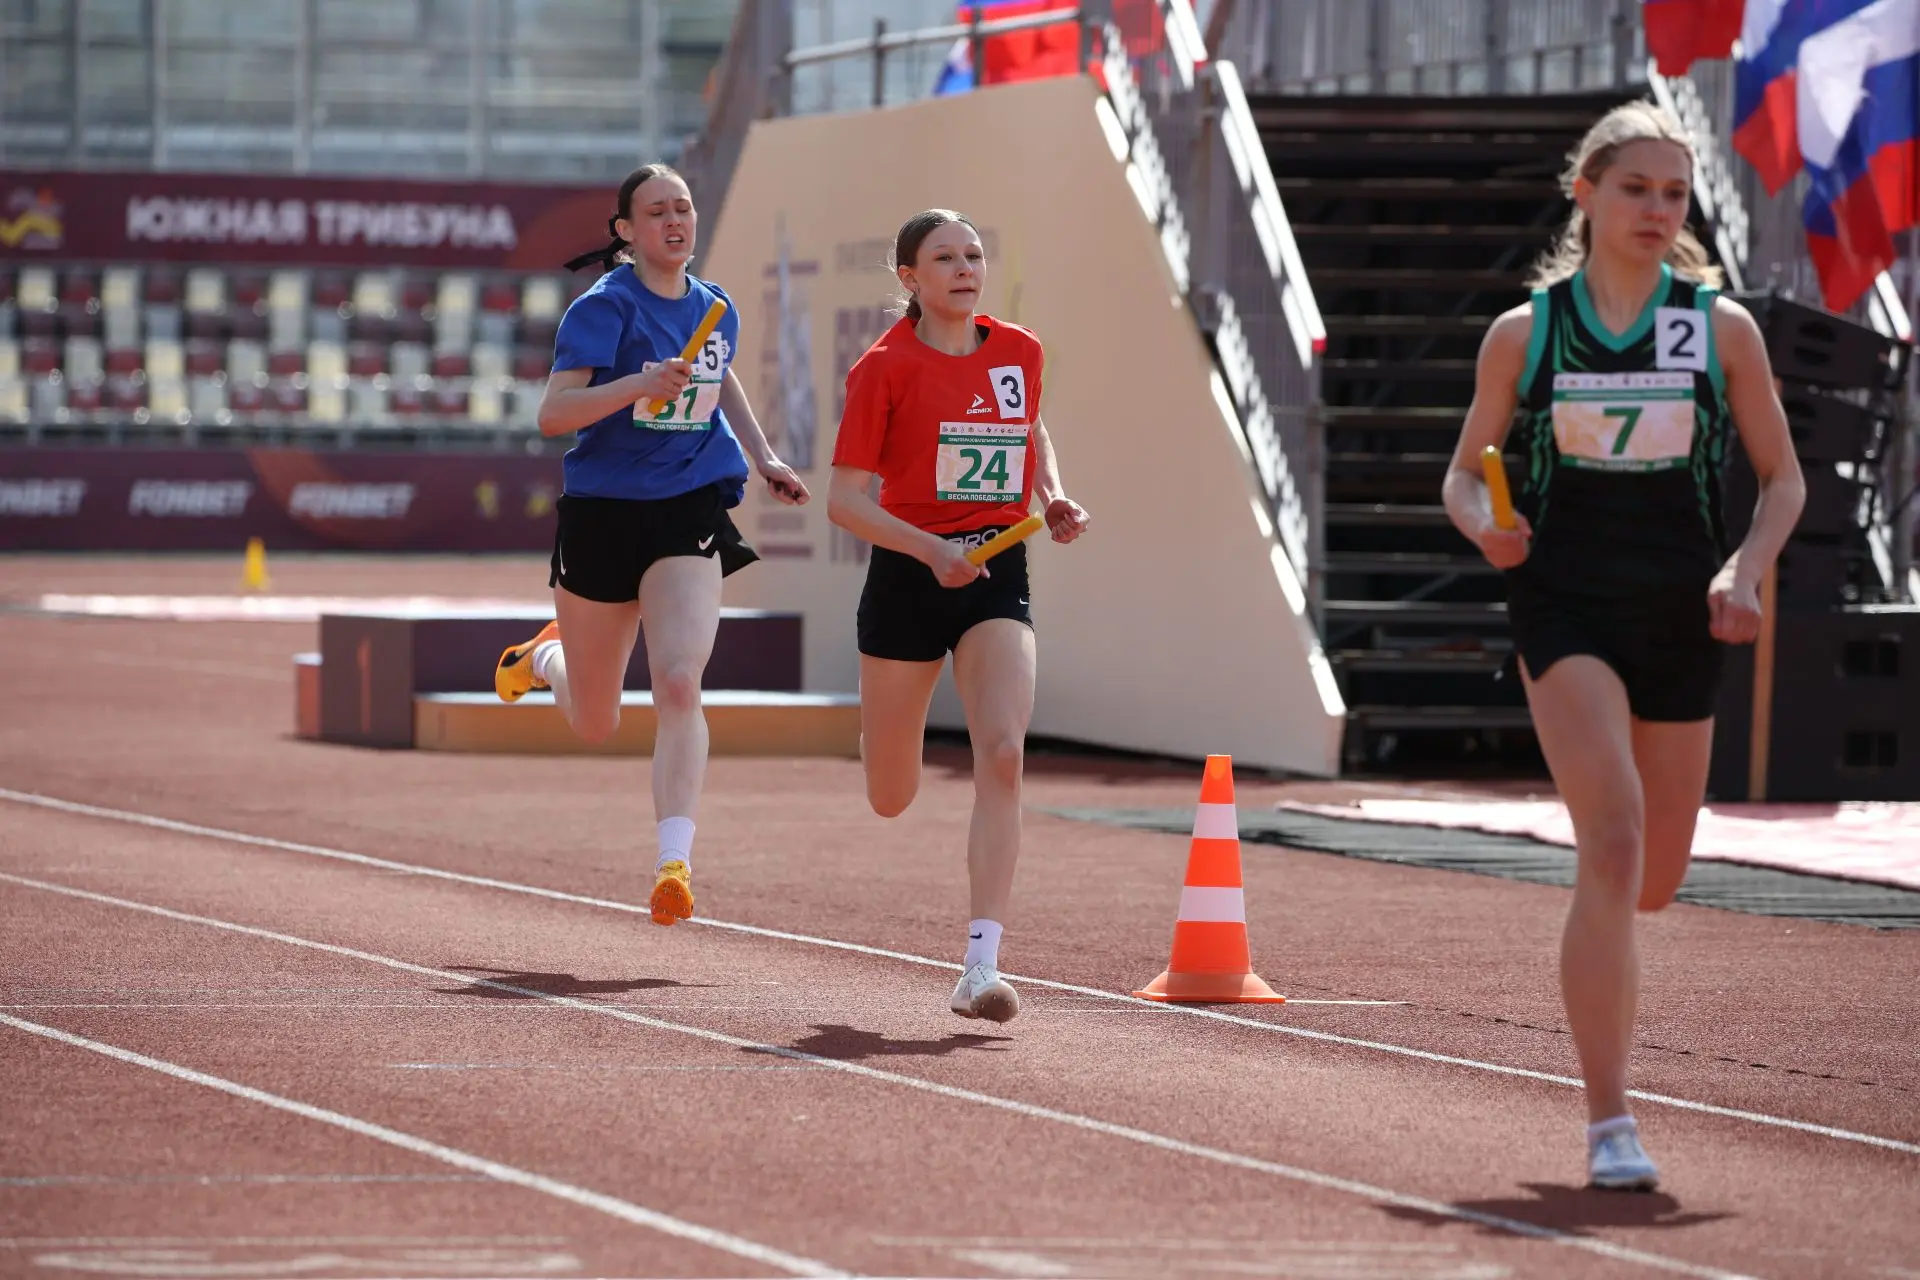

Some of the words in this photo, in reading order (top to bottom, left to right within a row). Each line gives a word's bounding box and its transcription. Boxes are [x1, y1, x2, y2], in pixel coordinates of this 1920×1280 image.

[126, 196, 307, 243] ЮЖНАЯ
[313, 199, 518, 249] ТРИБУНА
[703, 340, 718, 371] 5
[1668, 319, 1695, 358] 2
[1000, 375, 1022, 409] 3
[966, 407, 993, 415] DEMIX
[1602, 406, 1643, 455] 7
[956, 448, 1010, 490] 24
[947, 493, 969, 501] ВЕСНА
[970, 494, 997, 502] ПОБЕДЫ
